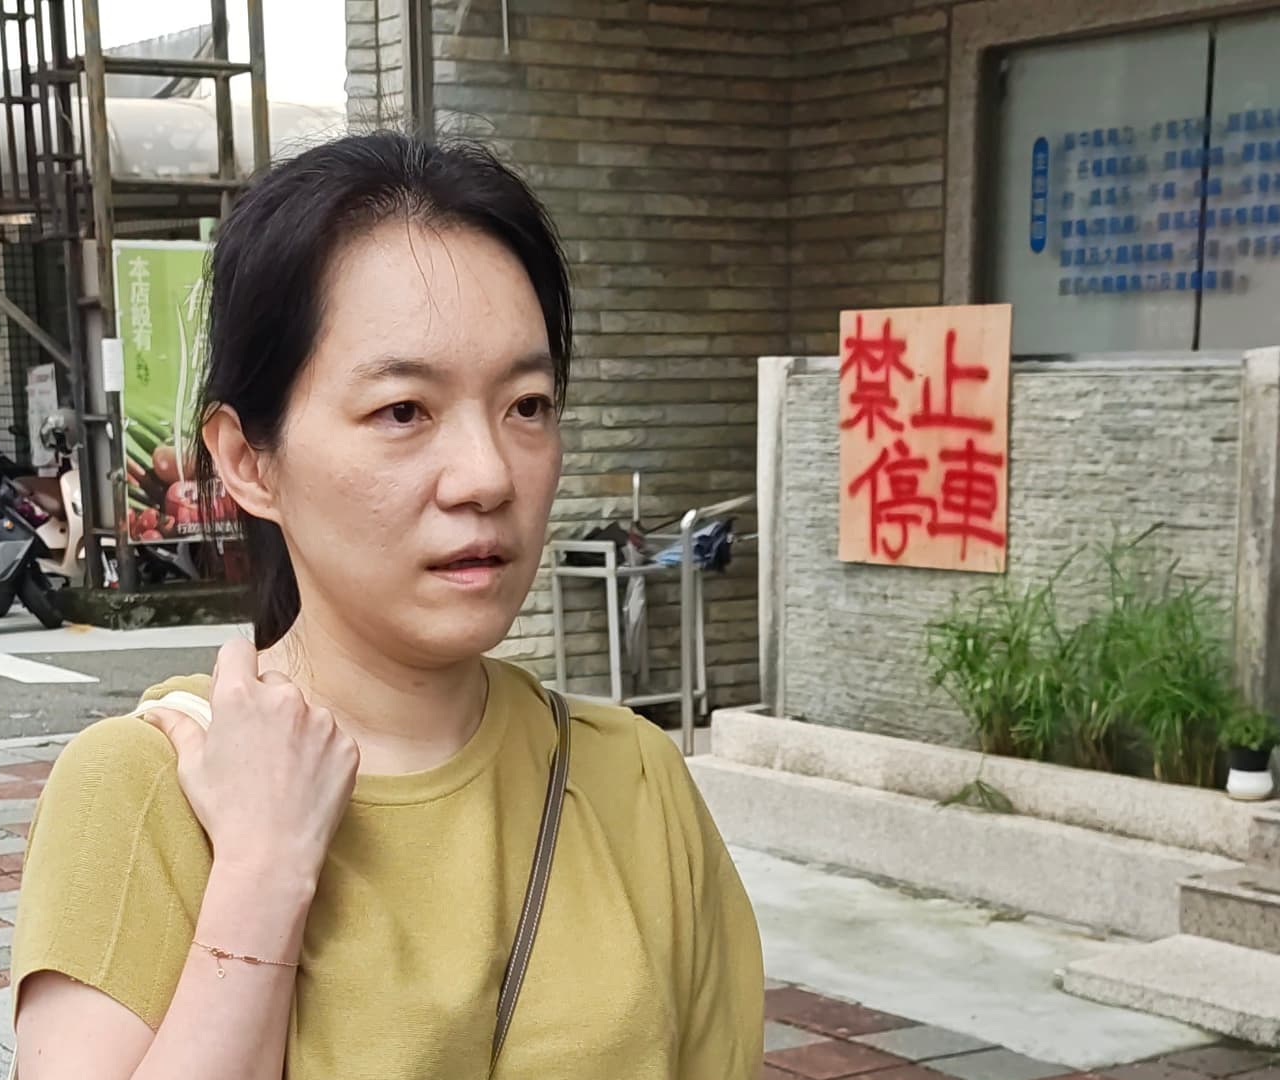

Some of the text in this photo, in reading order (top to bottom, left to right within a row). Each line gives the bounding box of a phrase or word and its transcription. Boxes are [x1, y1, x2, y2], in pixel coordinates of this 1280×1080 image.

[128, 255, 153, 351] 本店設有
[839, 313, 994, 441] 禁止
[848, 437, 1006, 562] 停車
